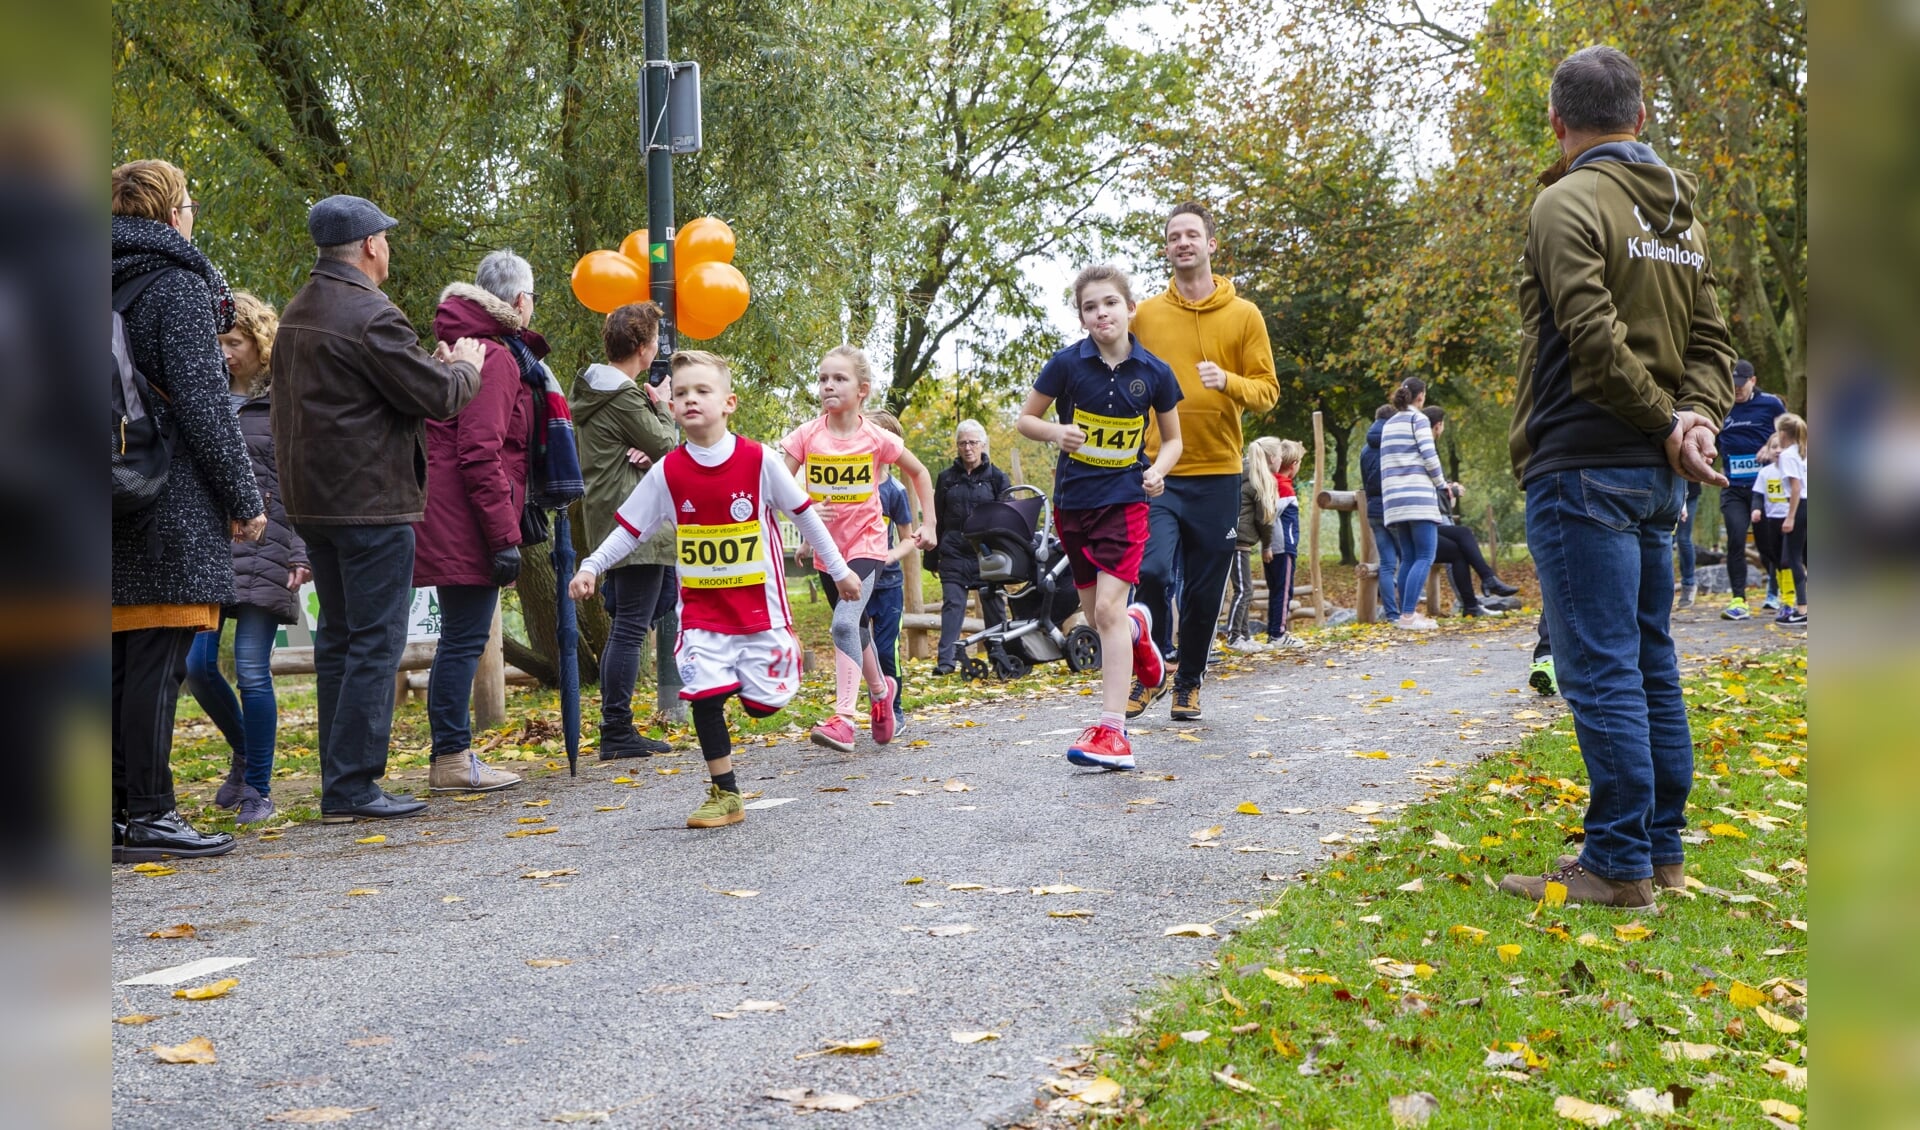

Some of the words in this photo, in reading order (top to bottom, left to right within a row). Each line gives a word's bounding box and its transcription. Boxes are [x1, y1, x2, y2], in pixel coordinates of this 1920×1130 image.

[1086, 456, 1124, 466] KROONTJE
[809, 465, 871, 485] 5044
[681, 536, 758, 565] 5007
[698, 577, 743, 585] KROONTJE
[768, 647, 792, 678] 21
